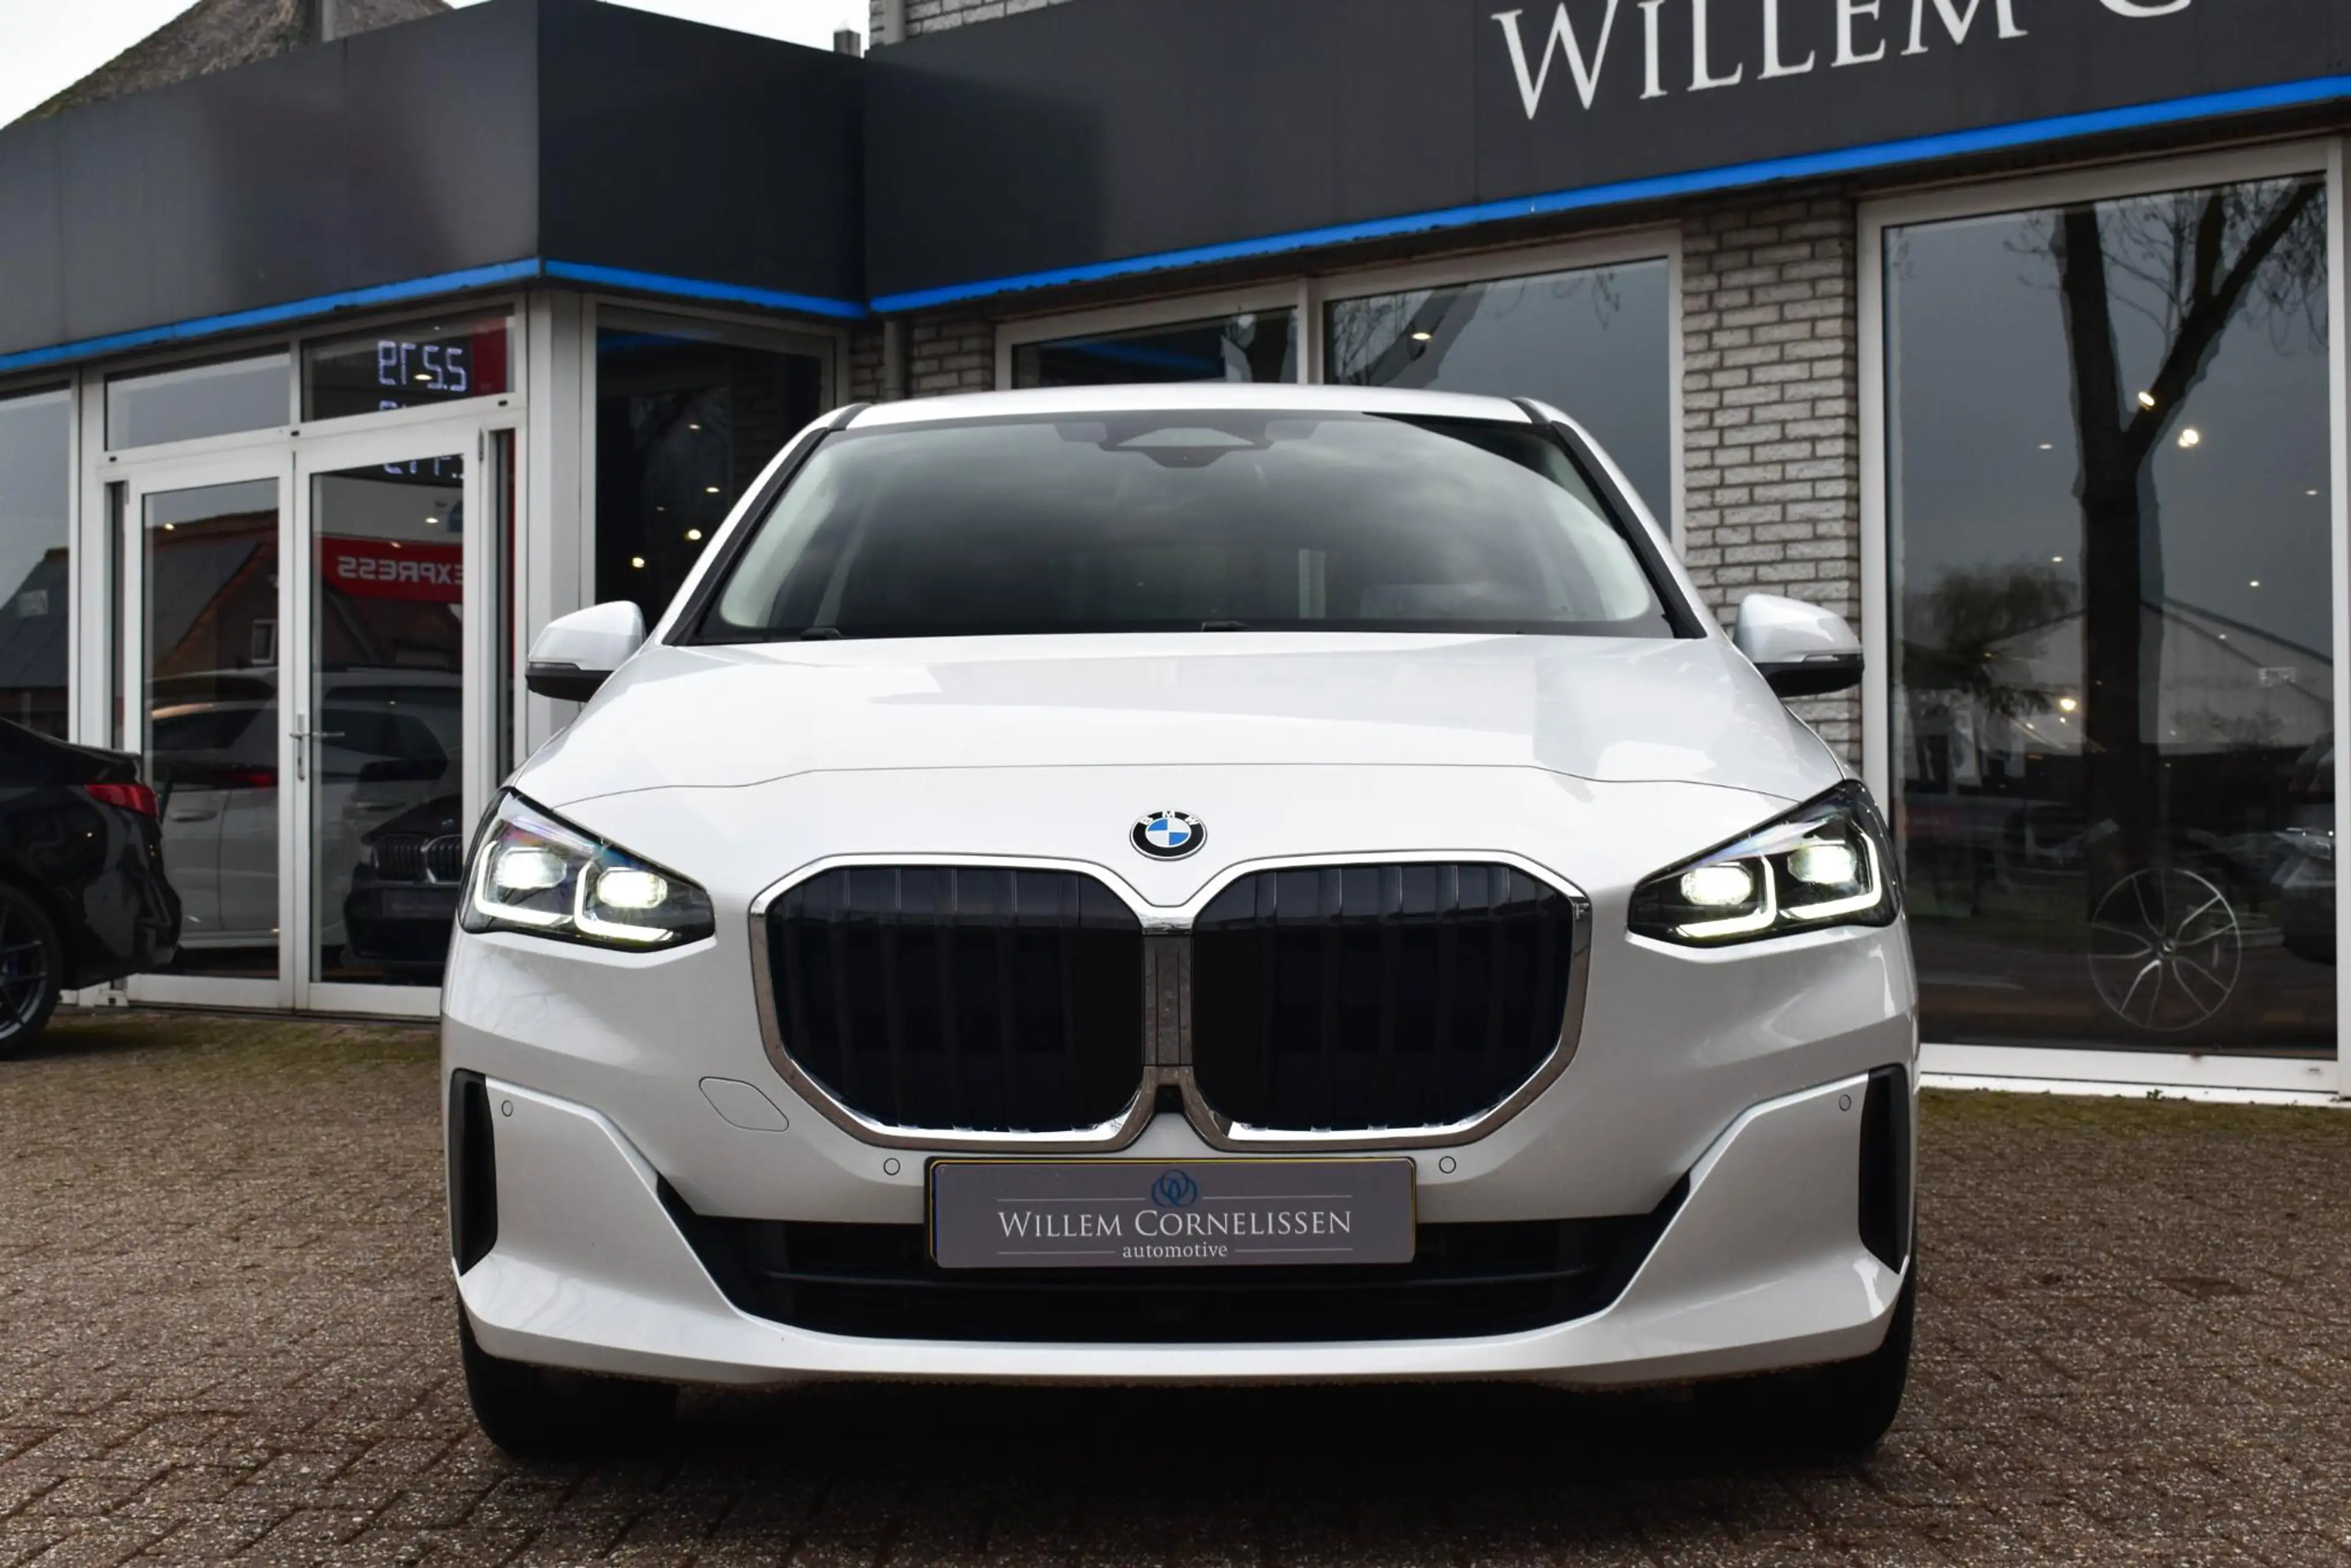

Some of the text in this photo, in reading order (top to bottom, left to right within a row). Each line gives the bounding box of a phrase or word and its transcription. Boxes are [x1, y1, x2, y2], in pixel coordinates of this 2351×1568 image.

[998, 1209, 1352, 1238] WILLEM CORNELISSEN
[1122, 1242, 1228, 1259] automotive
